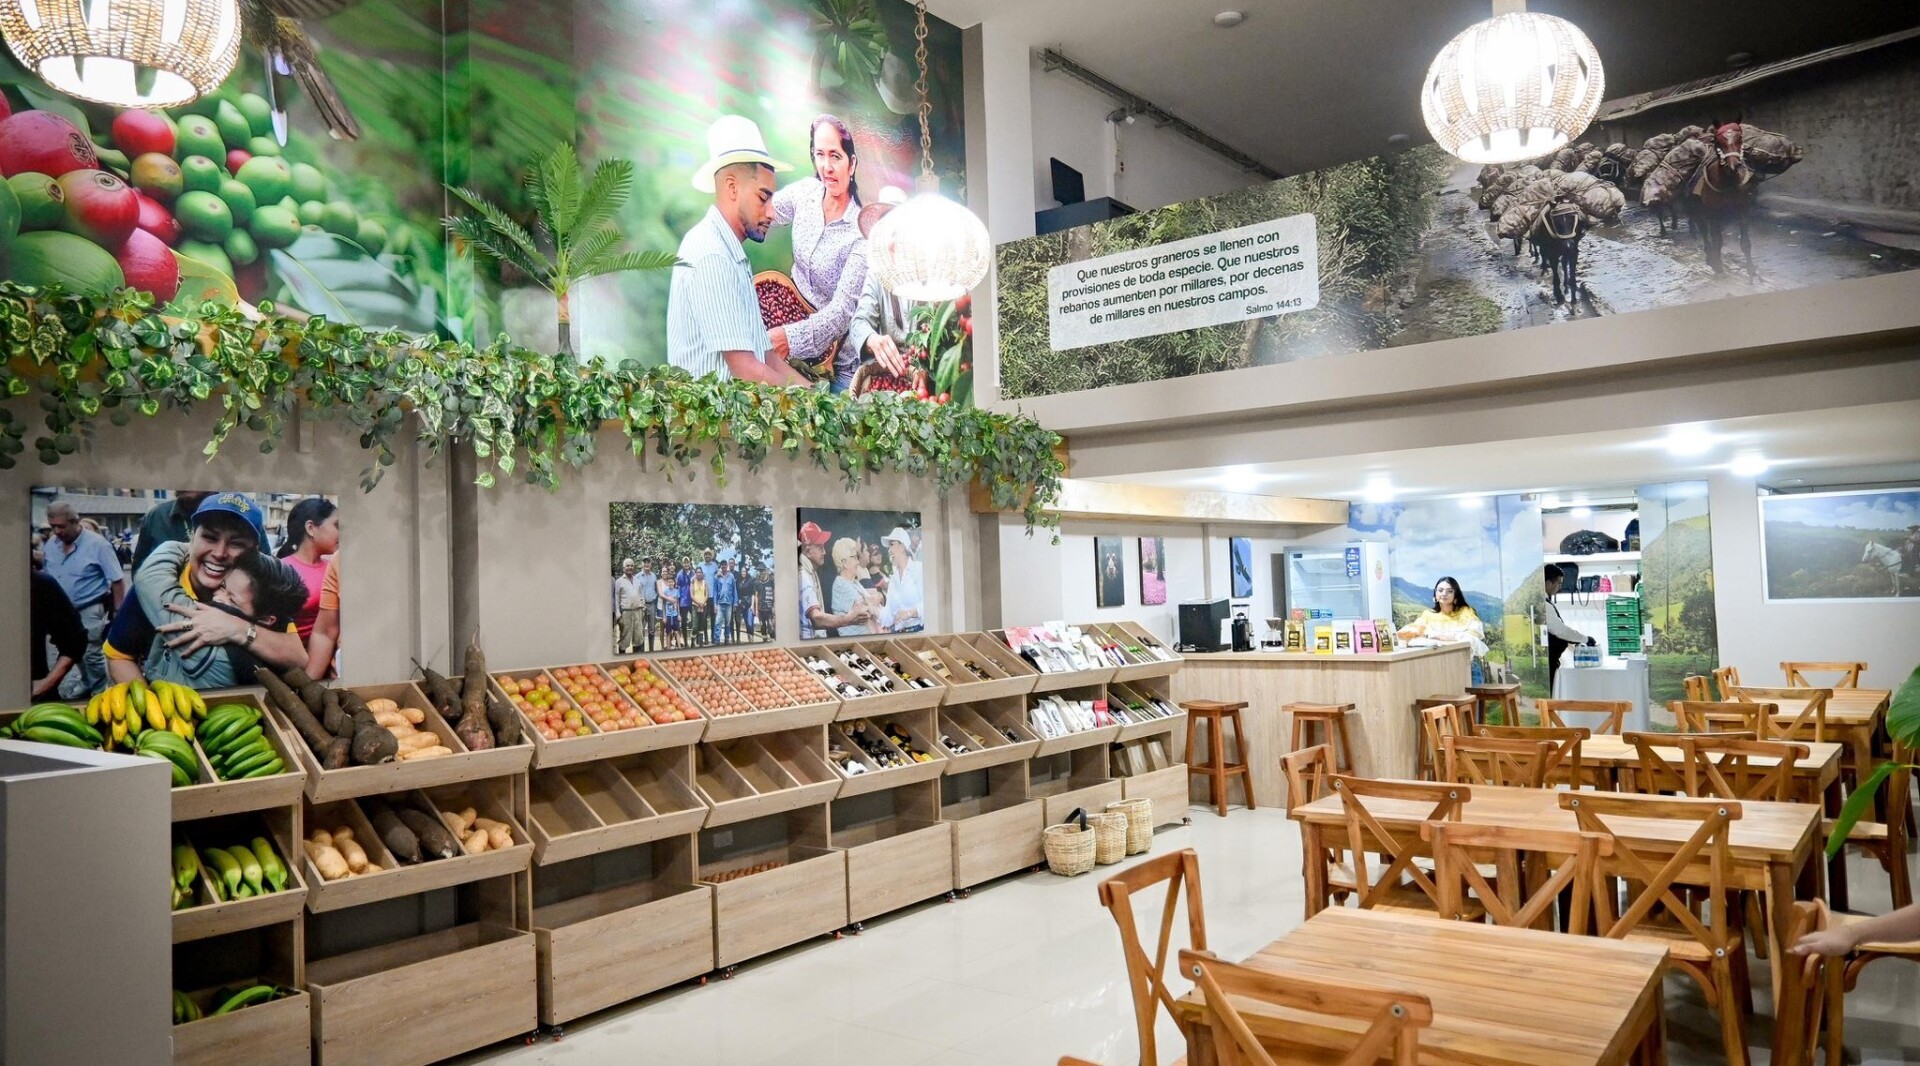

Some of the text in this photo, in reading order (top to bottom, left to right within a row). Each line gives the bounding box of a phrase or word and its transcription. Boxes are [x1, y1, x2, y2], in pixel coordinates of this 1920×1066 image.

[1062, 245, 1299, 301] provisiones de toda especie. Que nuestros
[1077, 232, 1280, 283] Que nuestros graneros se llenen con
[1090, 285, 1268, 324] de millares en nuestros campos.
[1103, 289, 1157, 307] aumenten
[1159, 285, 1178, 299] por
[1181, 276, 1227, 292] millares,
[1230, 272, 1249, 286] por
[1253, 261, 1304, 279] decenas
[1245, 297, 1302, 315] Salmo 144:13
